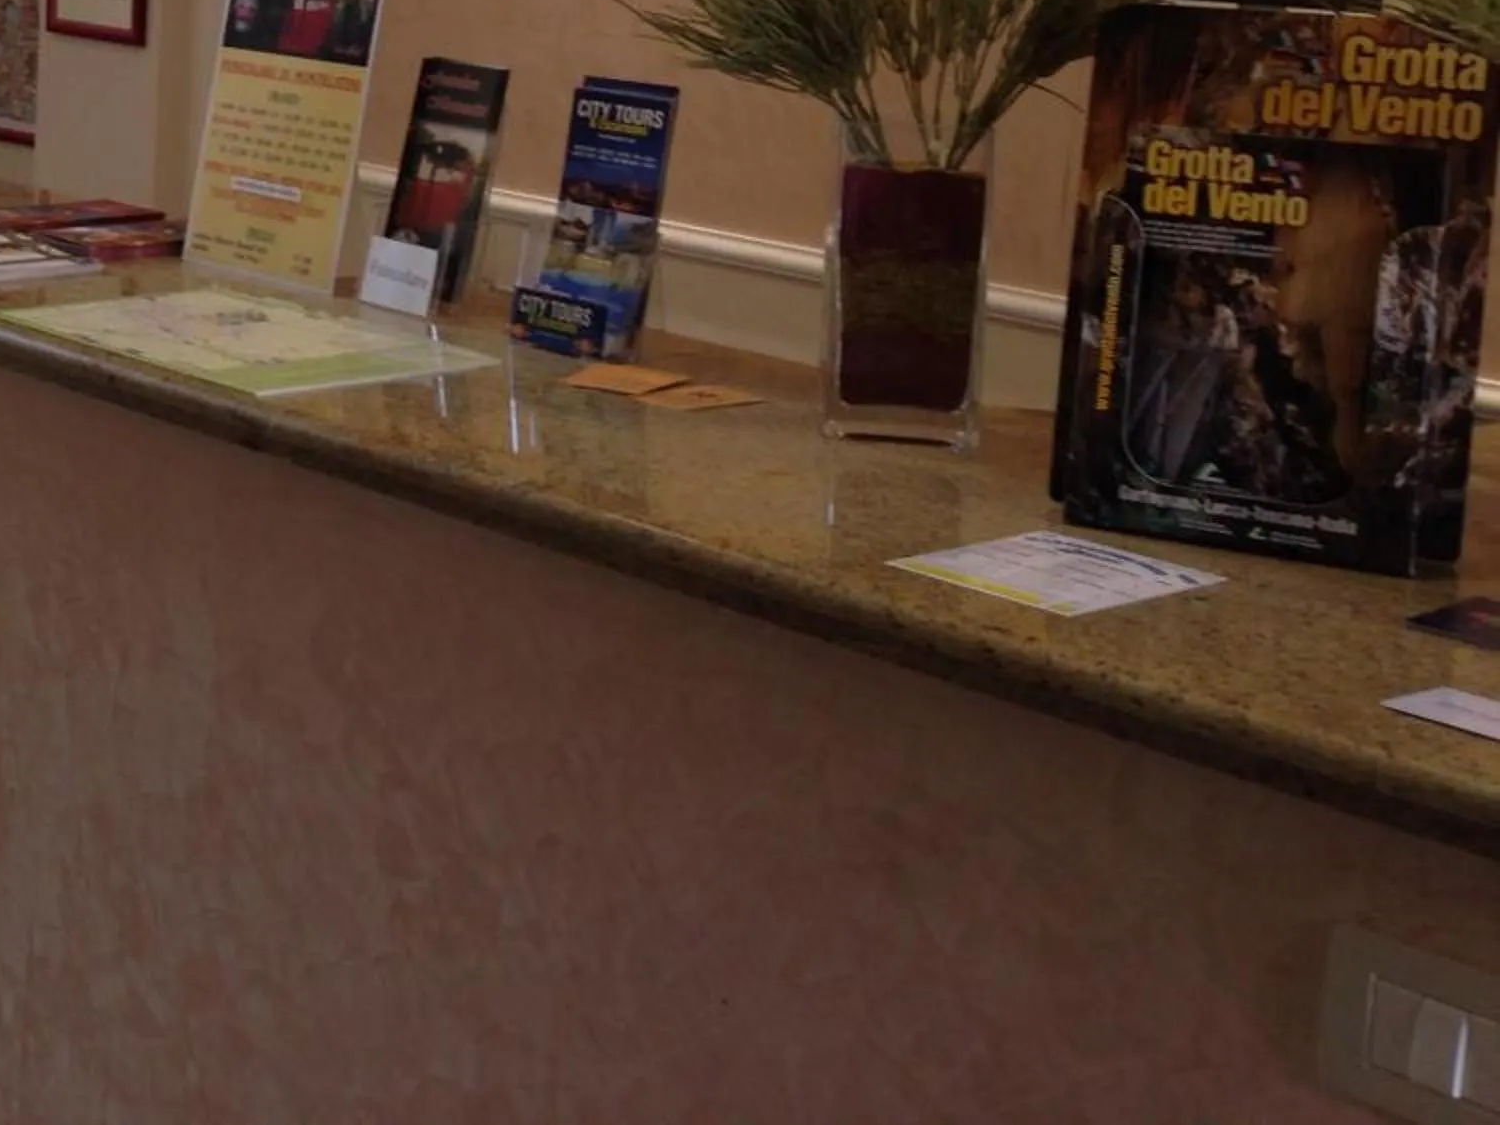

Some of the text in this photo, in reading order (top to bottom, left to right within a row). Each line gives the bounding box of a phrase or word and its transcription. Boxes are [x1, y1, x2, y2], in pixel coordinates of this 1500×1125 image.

[1341, 34, 1488, 92] Grotta
[577, 98, 612, 121] CITY
[614, 103, 665, 129] TOURS
[1261, 78, 1484, 142] del Vento
[1147, 138, 1256, 184] Grotta
[1143, 176, 1310, 226] del Vento
